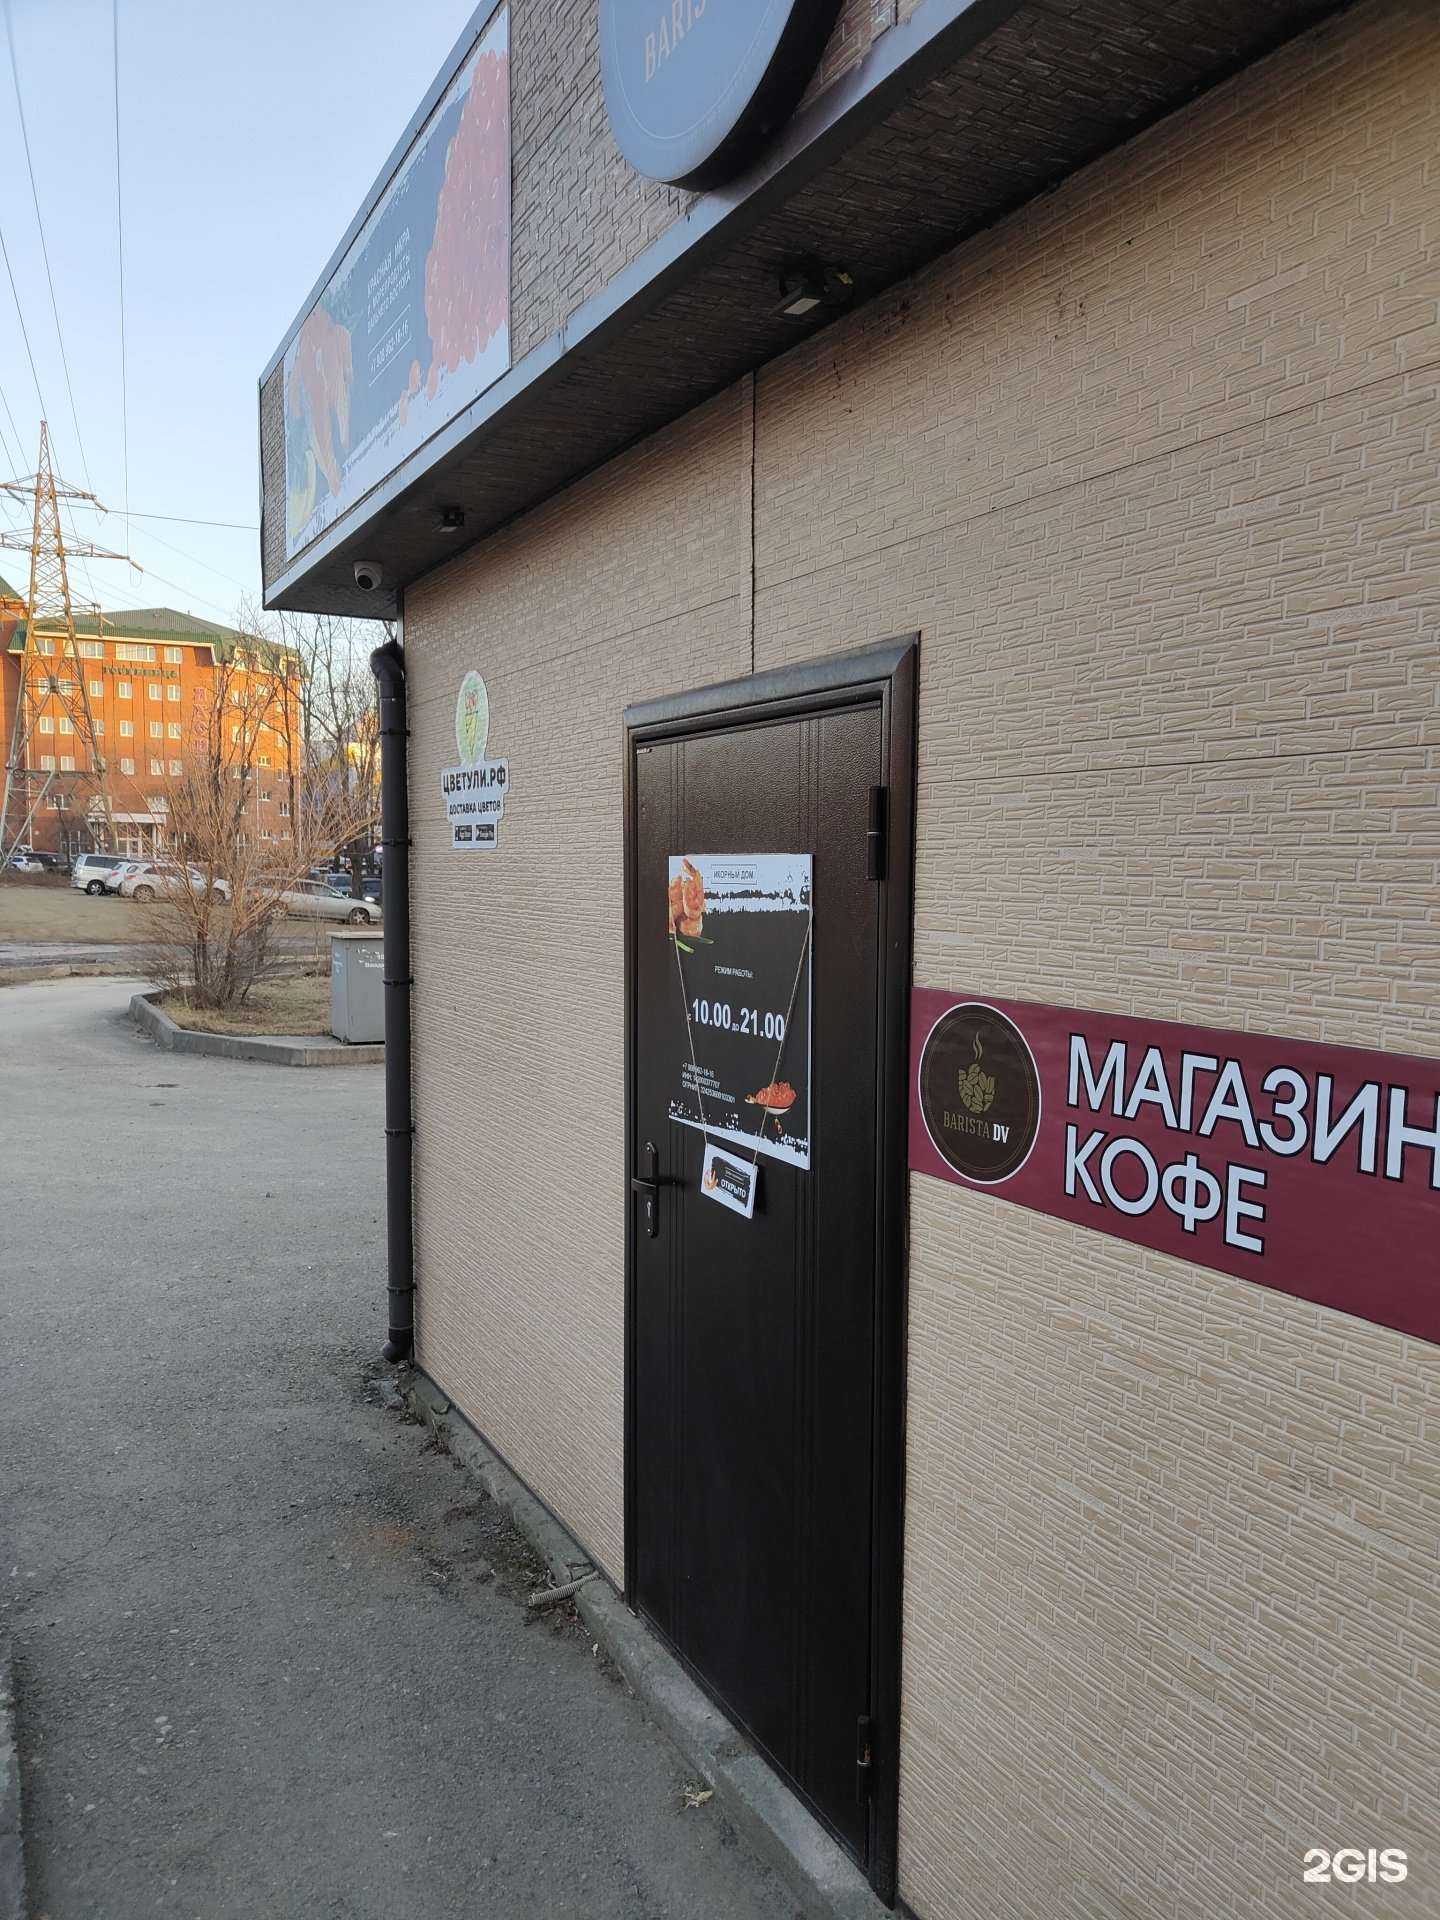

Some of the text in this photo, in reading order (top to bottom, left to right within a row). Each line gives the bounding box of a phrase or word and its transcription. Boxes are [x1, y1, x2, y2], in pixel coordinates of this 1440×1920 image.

[449, 800, 501, 816] ДОСТАВКА ЦВЕТОВ
[740, 870, 754, 880] ДОМ
[714, 965, 732, 976] РЕЖИМ
[692, 998, 731, 1030] 10.00
[740, 1007, 785, 1041] 21.00
[1067, 1033, 1440, 1191] МАГАЗИН
[943, 1111, 1010, 1144] BARISTA DV
[720, 1178, 746, 1198] ОТКРЫТО
[1064, 1123, 1267, 1255] КОФЕ
